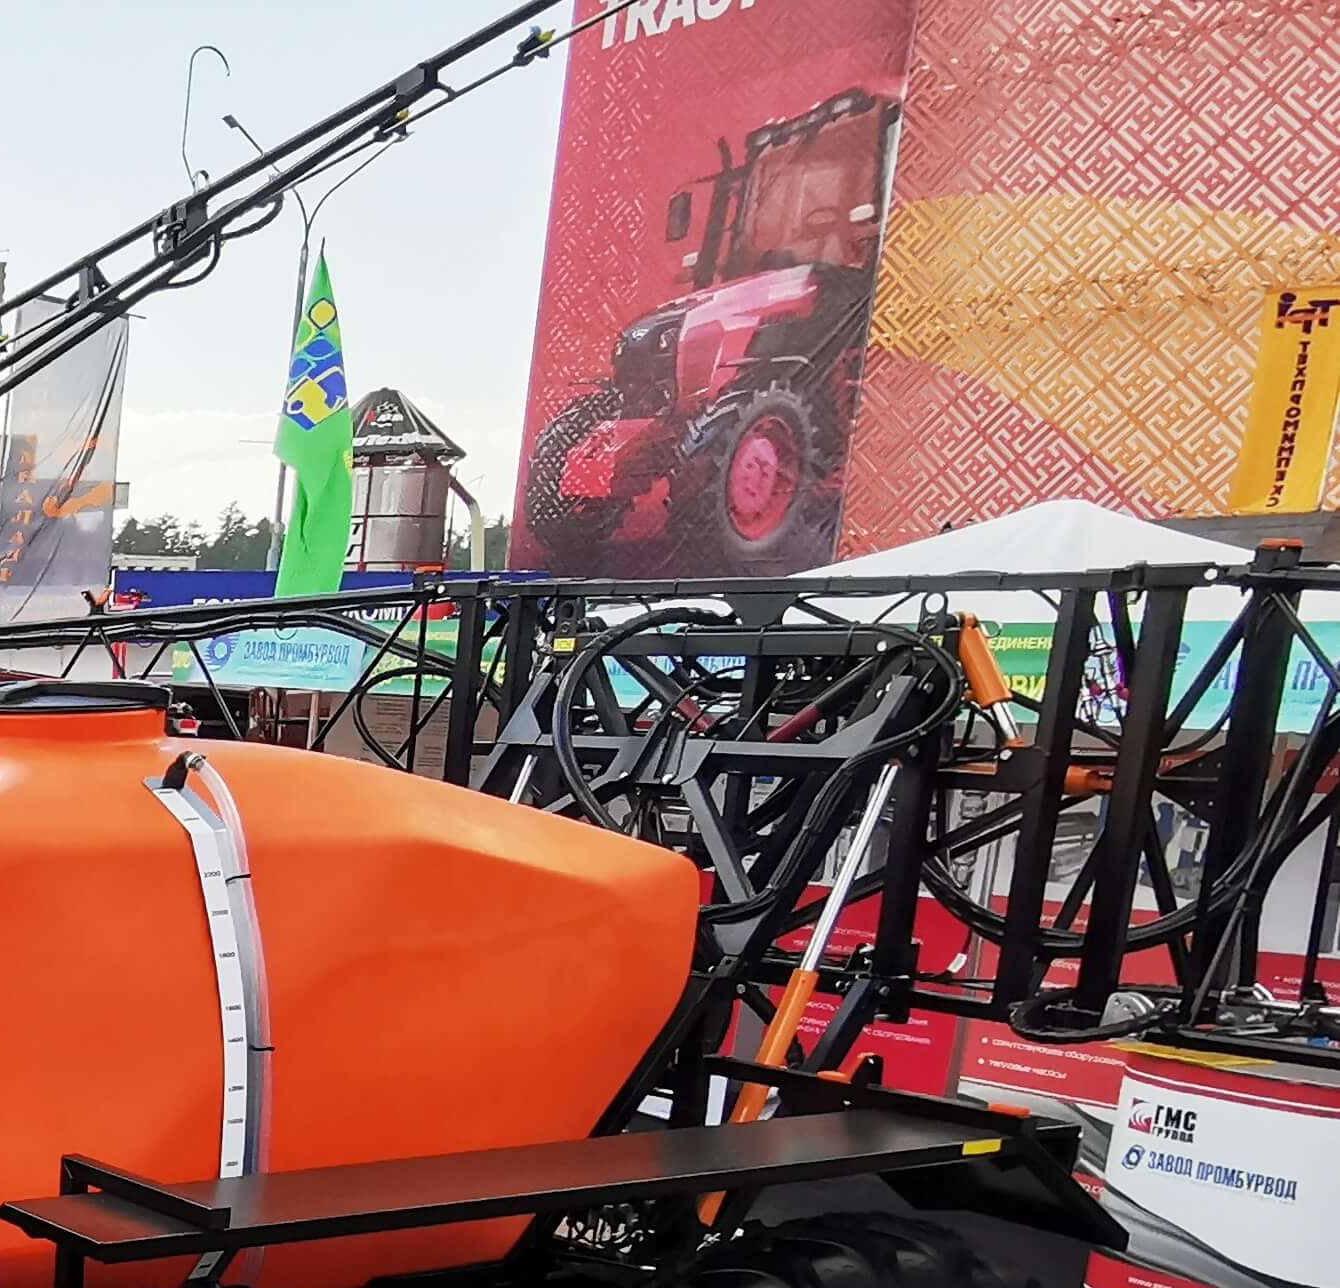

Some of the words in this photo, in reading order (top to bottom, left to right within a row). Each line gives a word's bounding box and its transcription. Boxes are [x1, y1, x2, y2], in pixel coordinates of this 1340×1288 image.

[1154, 1105, 1197, 1131] ГМС
[1152, 1126, 1194, 1143] ГРУППА
[1147, 1151, 1193, 1176] ЗАВОД
[1196, 1162, 1298, 1200] ПРОМБУРВОД
